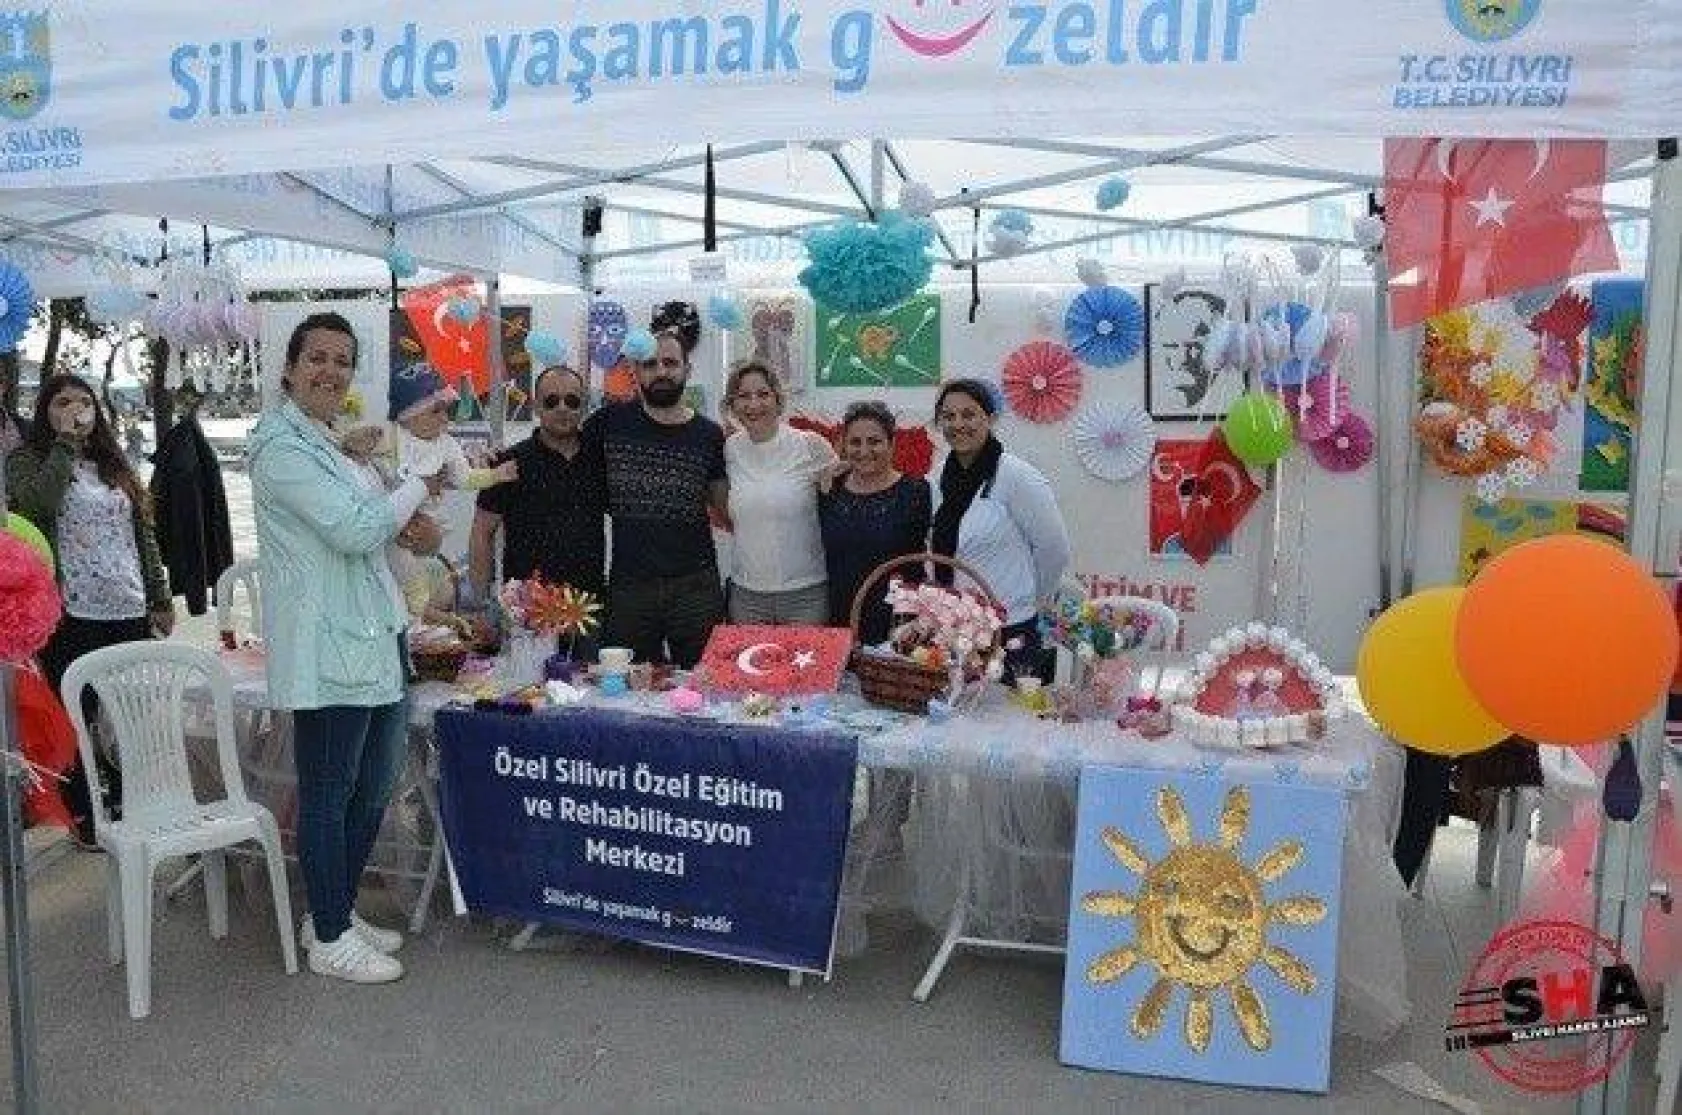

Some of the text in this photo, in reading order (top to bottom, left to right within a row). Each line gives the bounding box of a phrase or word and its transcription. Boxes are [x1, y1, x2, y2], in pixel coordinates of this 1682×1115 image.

[168, 22, 458, 120] Silivri'de
[484, 0, 801, 111] yaşamak
[1160, 584, 1196, 613] VE
[494, 746, 783, 811] Özel Silivri Özel Eğitim
[523, 796, 752, 846] ve Rehabilitasyon
[585, 838, 685, 876] Merkezi
